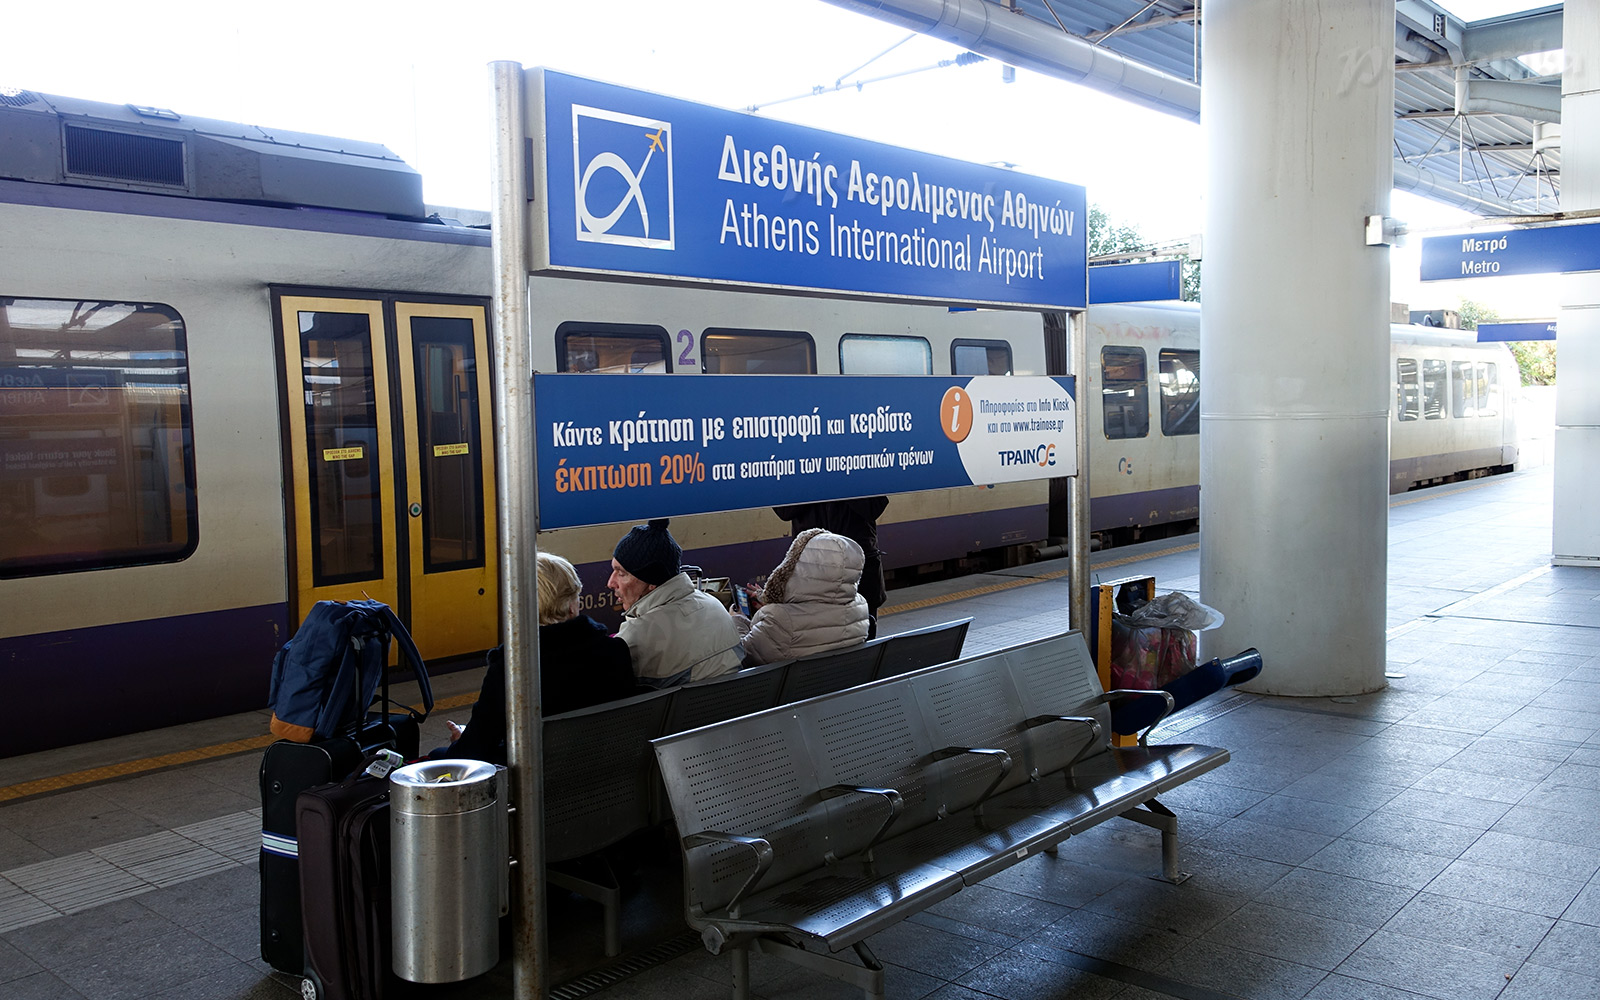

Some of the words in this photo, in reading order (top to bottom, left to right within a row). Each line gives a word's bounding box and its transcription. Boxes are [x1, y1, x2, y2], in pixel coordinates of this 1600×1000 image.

[718, 135, 837, 209] Διεθνής
[1001, 190, 1074, 239] Αθηνών
[719, 198, 820, 255] Athens
[830, 213, 971, 272] International
[978, 236, 1044, 284] Airport
[1462, 236, 1508, 253] Μετρό
[1461, 261, 1500, 275] Metro
[677, 329, 696, 366] 2
[980, 399, 1025, 416] Πληροφορίες
[1026, 402, 1038, 412] στο
[1039, 398, 1051, 411] Info
[1052, 398, 1069, 411] Kiosk
[987, 423, 999, 433] και
[1000, 422, 1012, 433] στο
[1013, 418, 1064, 432] www.trainose.gr
[552, 421, 602, 447] Κάντε
[609, 411, 694, 451] κράτηση
[702, 417, 725, 447] με
[732, 407, 821, 443] επιστροφή
[827, 419, 845, 434] και
[851, 406, 912, 439] κερδίστε
[555, 458, 651, 493] έκπτωση
[660, 452, 705, 485] 20%
[712, 463, 735, 481] στα
[740, 454, 795, 480] εισιτήρια
[799, 457, 822, 475] των
[826, 448, 895, 475] υπεραστικών
[898, 446, 934, 470] τρένων
